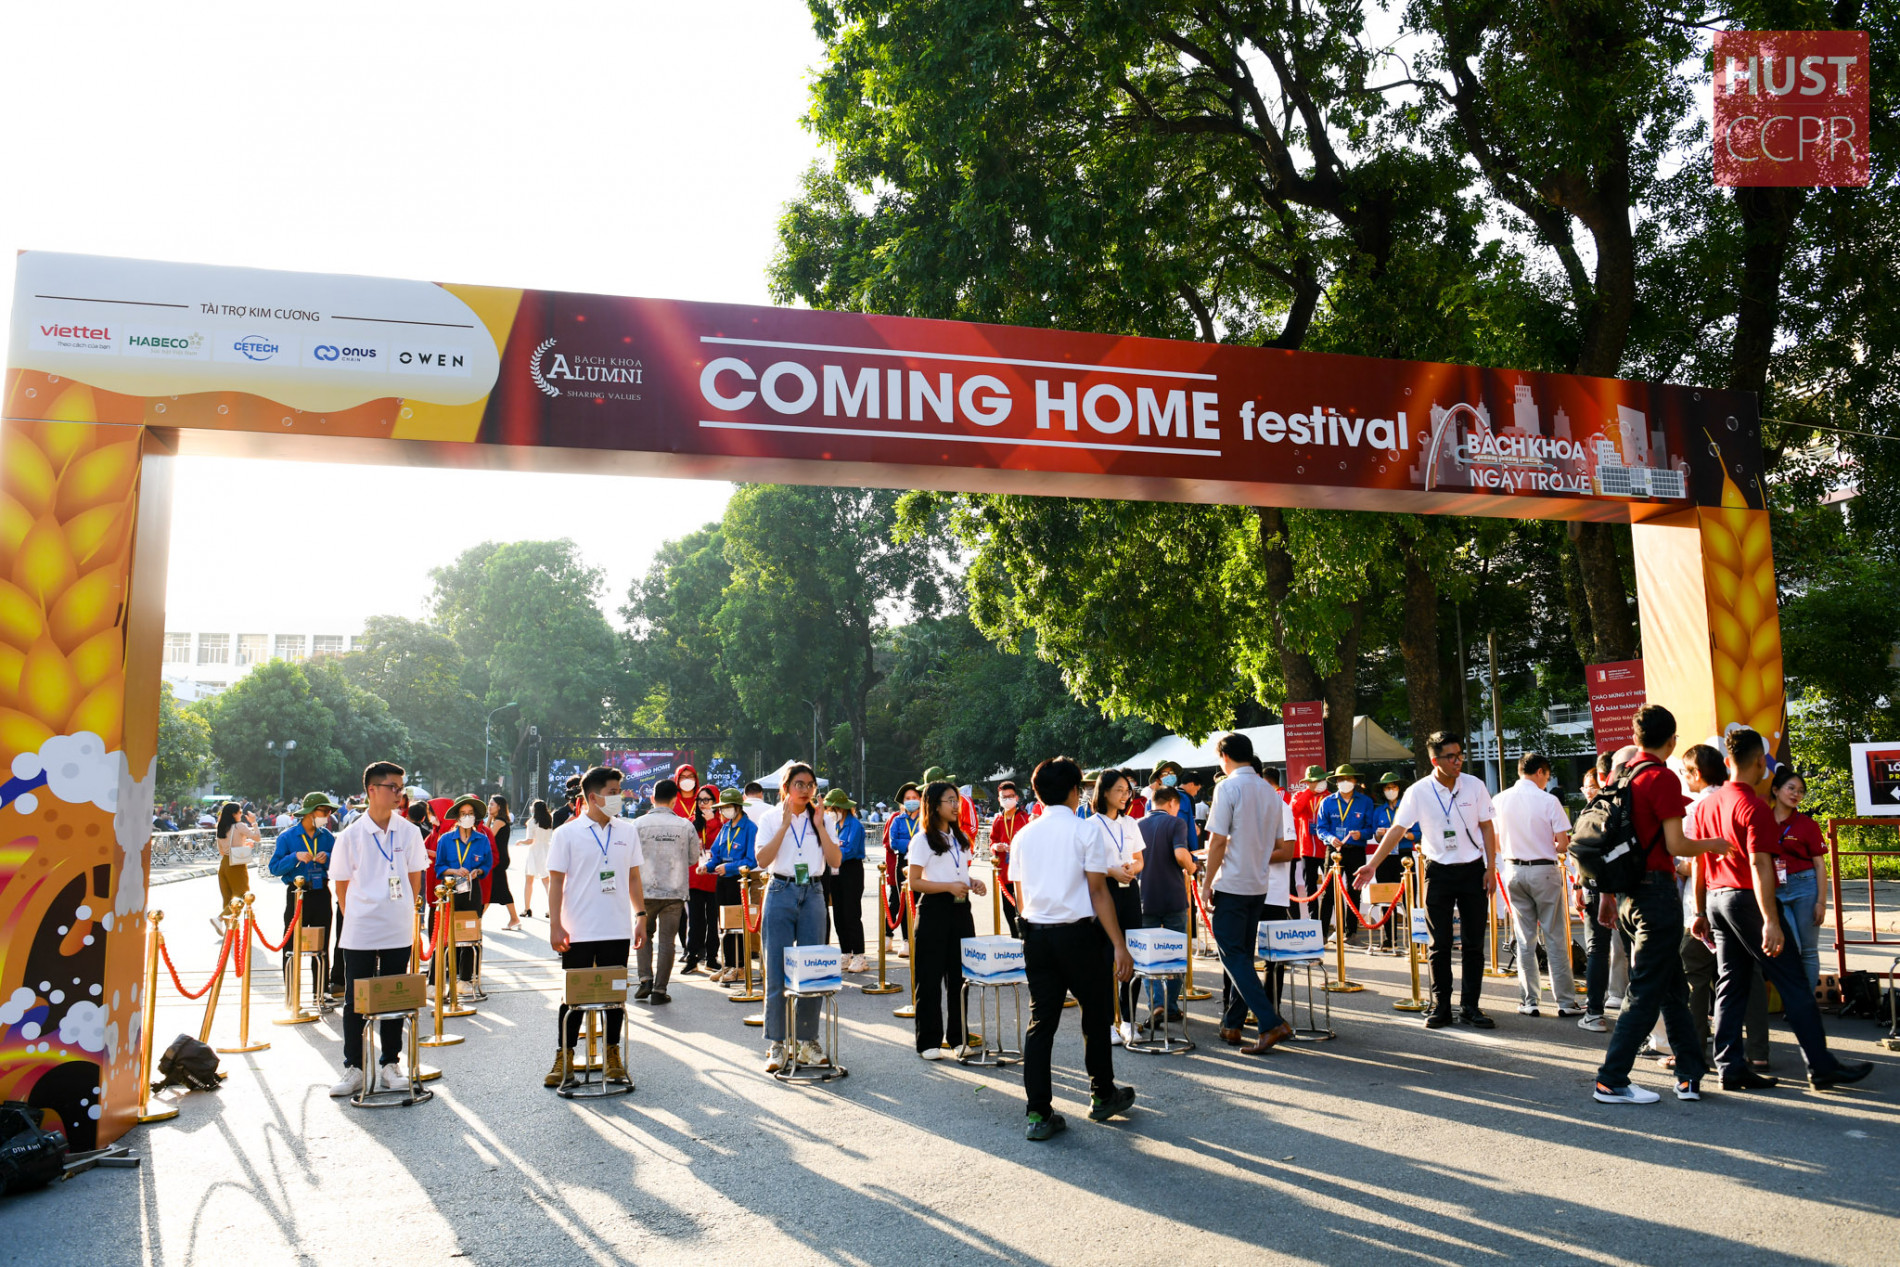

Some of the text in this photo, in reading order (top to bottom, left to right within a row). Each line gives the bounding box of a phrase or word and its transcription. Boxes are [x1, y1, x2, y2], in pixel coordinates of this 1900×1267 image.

[200, 302, 320, 321] TÀI TRỢ KIM CƯƠNG
[40, 324, 111, 340] viettel
[129, 335, 189, 349] HABECO
[233, 342, 279, 353] CETECH
[399, 351, 464, 367] OWEN
[574, 355, 642, 367] BACH KHOA
[546, 353, 643, 384] ALUMNI
[567, 390, 642, 401] SHARING VALUES
[699, 357, 1409, 450] COMING HOME festival
[1529, 437, 1587, 461] KHOA
[1469, 464, 1525, 490] NGÀY
[1594, 704, 1606, 712] 66
[626, 763, 671, 780] COMING HOME
[1275, 928, 1317, 941] UniAqua
[1154, 942, 1183, 951] UniAqua
[964, 947, 987, 961] UniAqua
[994, 951, 1024, 960] UniAqua
[804, 959, 837, 967] UniAqua
